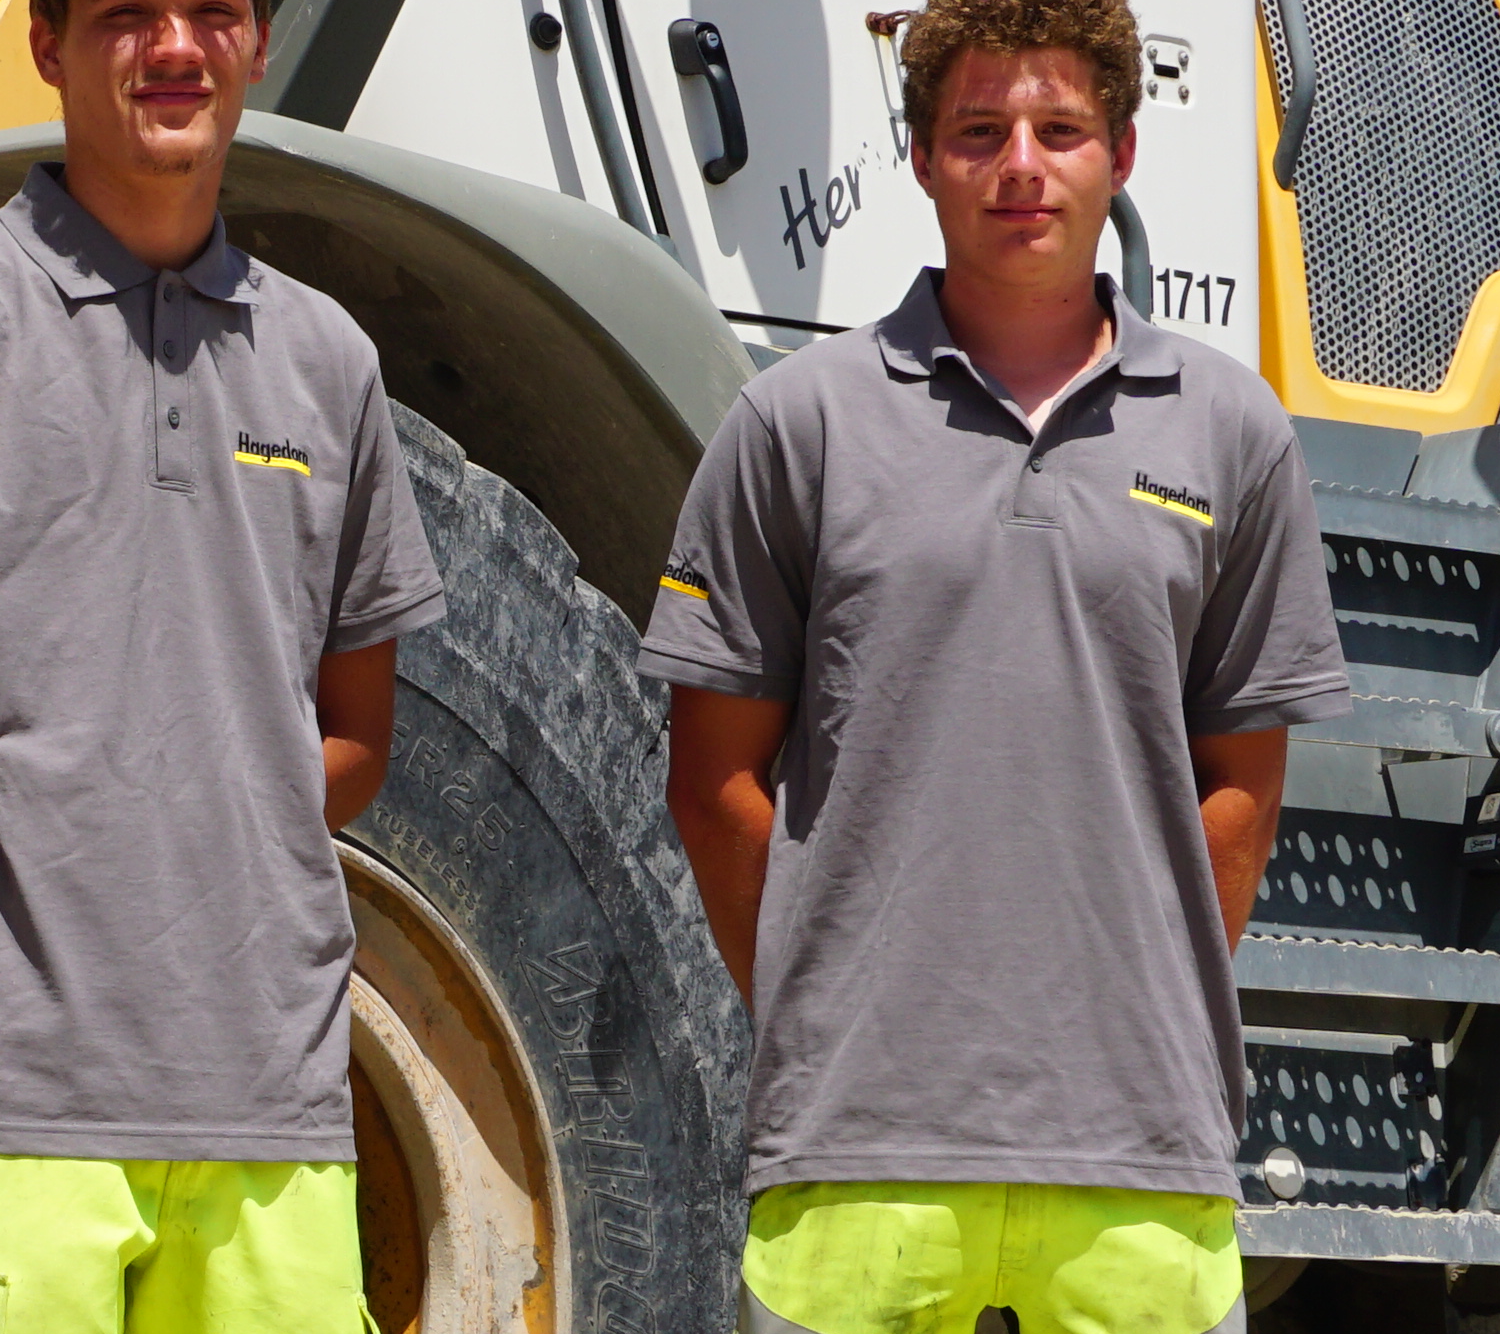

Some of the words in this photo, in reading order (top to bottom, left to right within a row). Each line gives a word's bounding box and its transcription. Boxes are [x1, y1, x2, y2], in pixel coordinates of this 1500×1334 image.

[238, 431, 309, 466] Hagedorn
[1135, 472, 1211, 515] Hagedorn
[370, 800, 477, 912] TUBELESS
